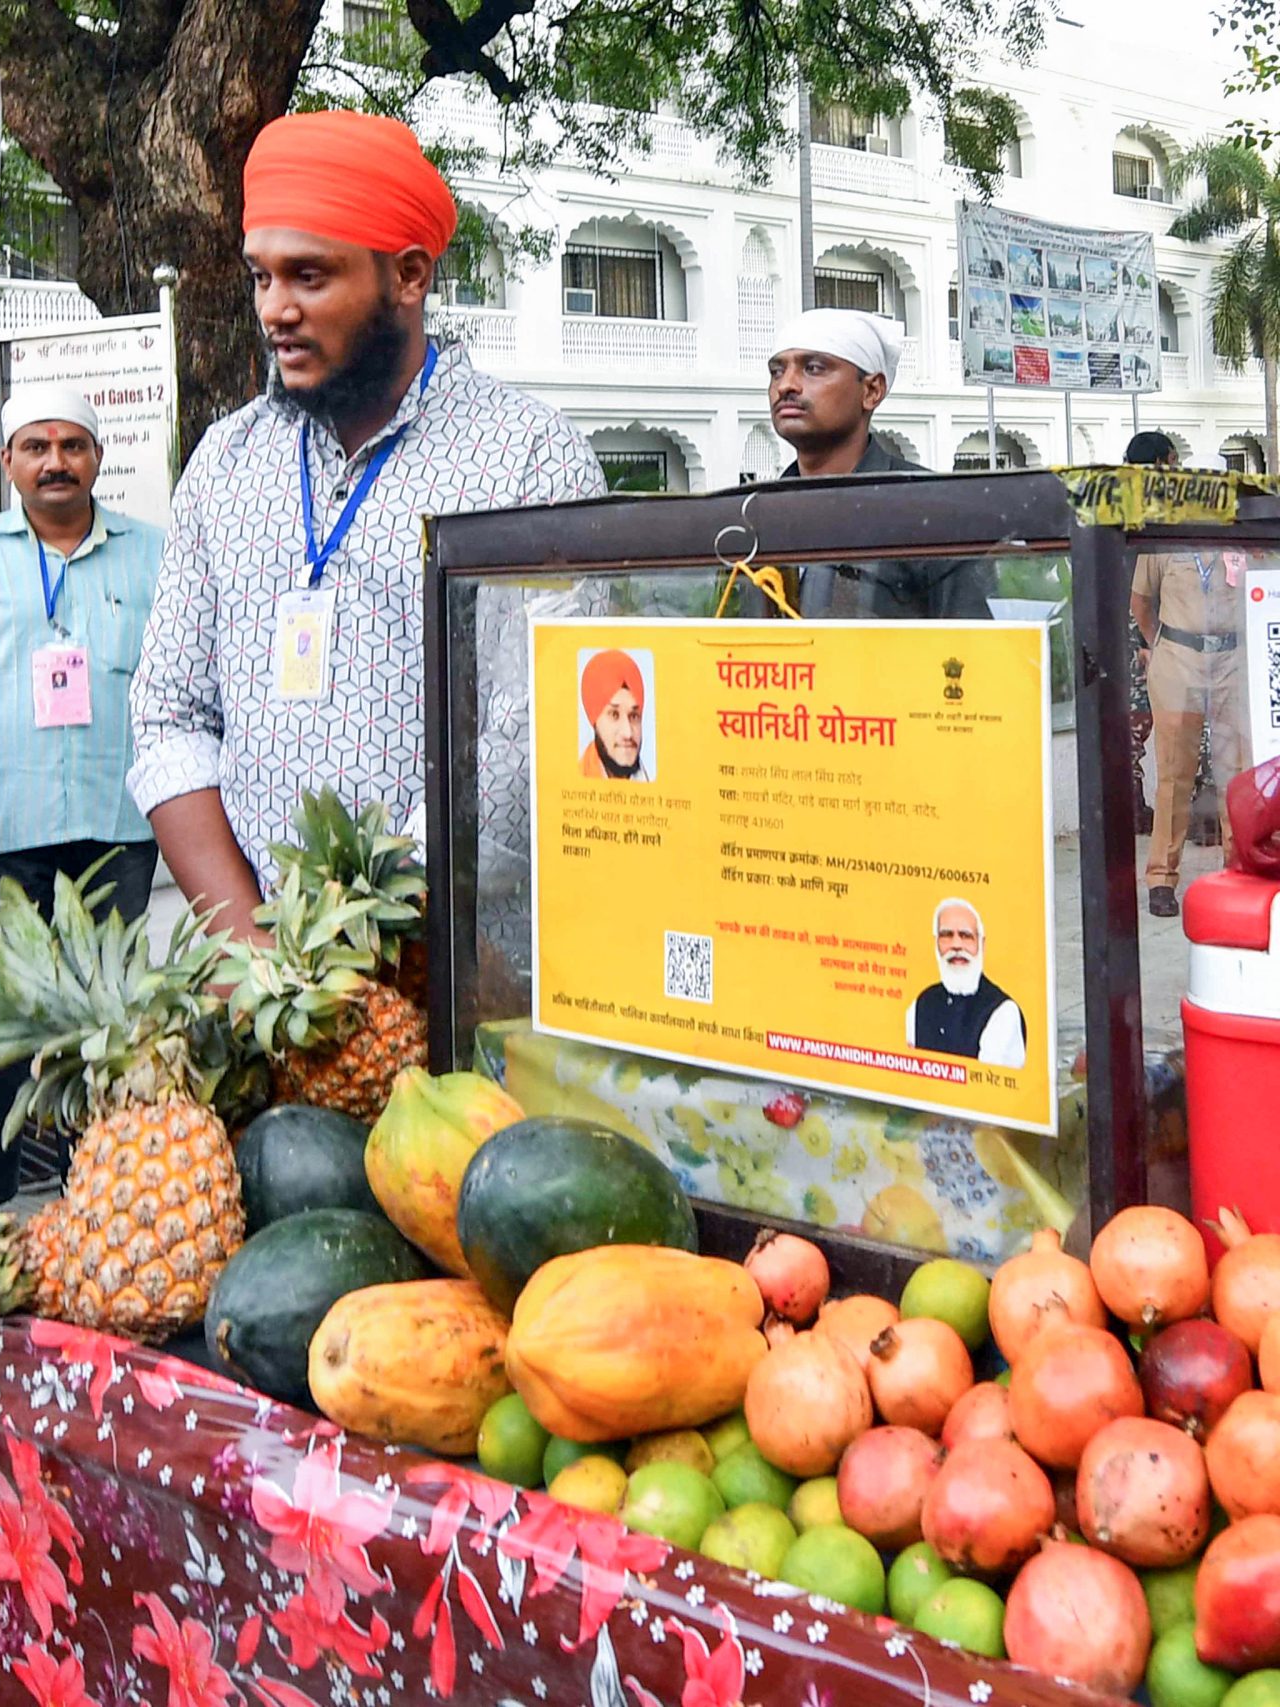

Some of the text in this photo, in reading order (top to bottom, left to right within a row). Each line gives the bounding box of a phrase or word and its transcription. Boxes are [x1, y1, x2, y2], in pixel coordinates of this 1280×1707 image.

[94, 389, 105, 407] of
[109, 388, 144, 406] Gates
[147, 384, 164, 402] 1-2
[112, 433, 138, 446] Singh
[1144, 475, 1229, 510] UltraTech
[716, 652, 816, 691] पंतप्रधान
[716, 702, 897, 746] स्वानिधी योजना
[825, 855, 991, 885] MH/251401/230912/6006574
[769, 1034, 965, 1083] WWW.PMSVANIDHI.MOHUA.GOV.IN
